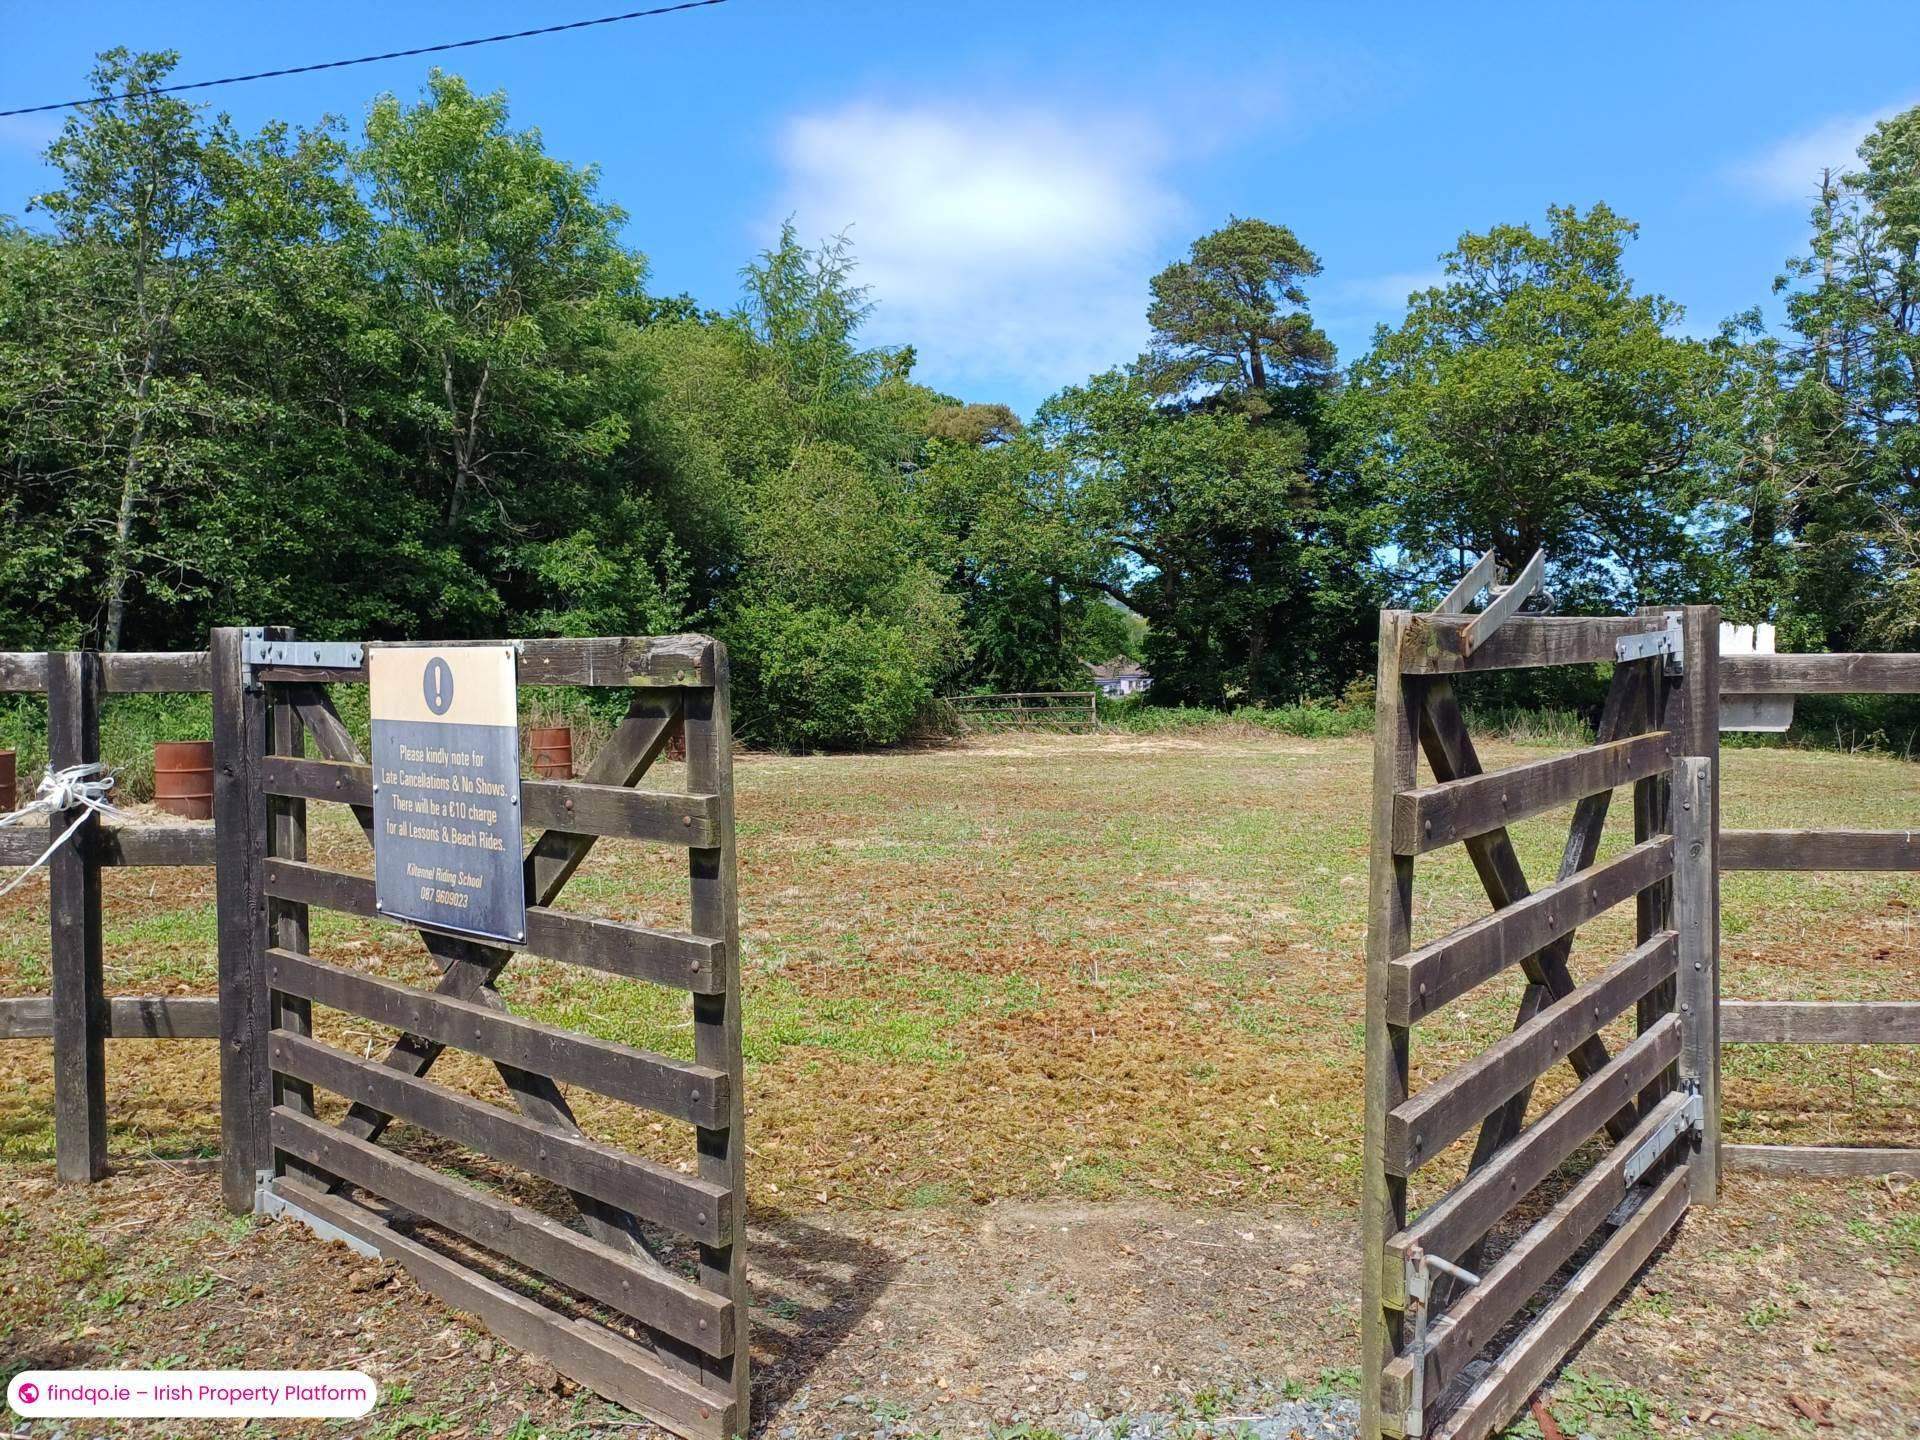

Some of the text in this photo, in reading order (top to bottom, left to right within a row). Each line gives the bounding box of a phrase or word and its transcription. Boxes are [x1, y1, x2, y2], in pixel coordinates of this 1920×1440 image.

[399, 744, 484, 768] Please kindly note for
[381, 767, 508, 797] Late Cancellations & No Shows.
[392, 794, 497, 826] There will be a €10 charge
[386, 818, 506, 851] for all Lessons & Beach Rides.
[435, 867, 457, 887] Riding
[458, 871, 483, 889] School
[420, 886, 435, 901] 087
